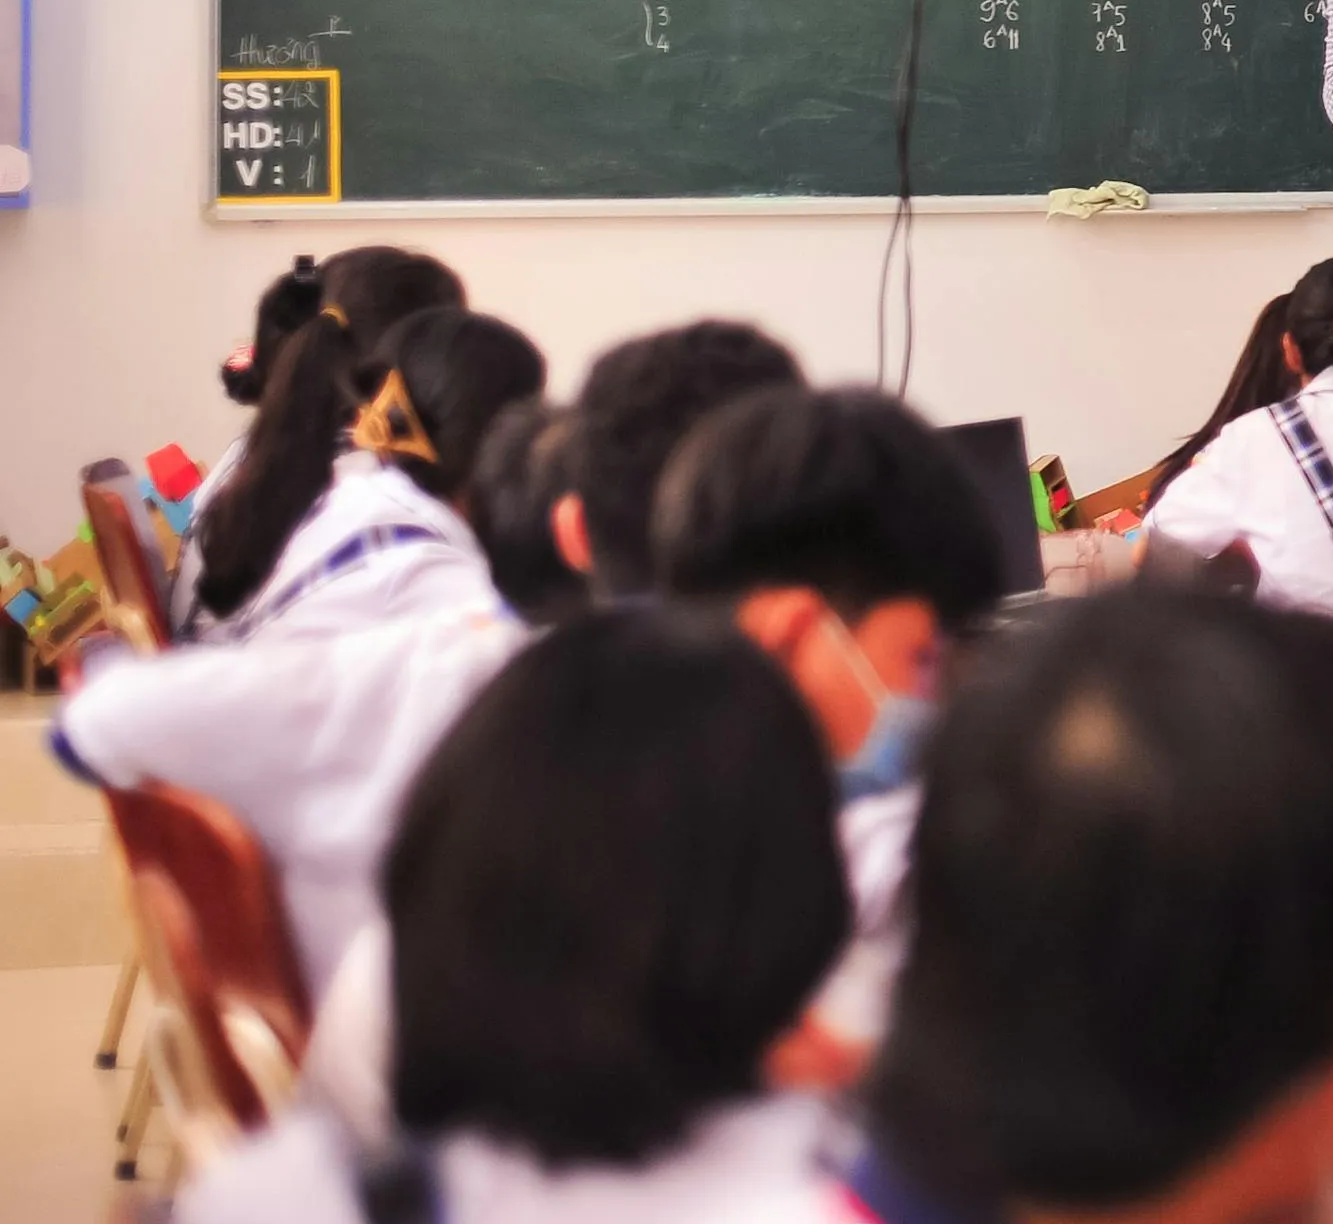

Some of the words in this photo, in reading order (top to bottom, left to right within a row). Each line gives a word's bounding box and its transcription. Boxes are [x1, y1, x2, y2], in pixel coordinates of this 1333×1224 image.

[656, 6, 672, 27] 3
[655, 33, 671, 54] 4
[221, 82, 284, 110] SS:
[222, 121, 284, 150] HD:
